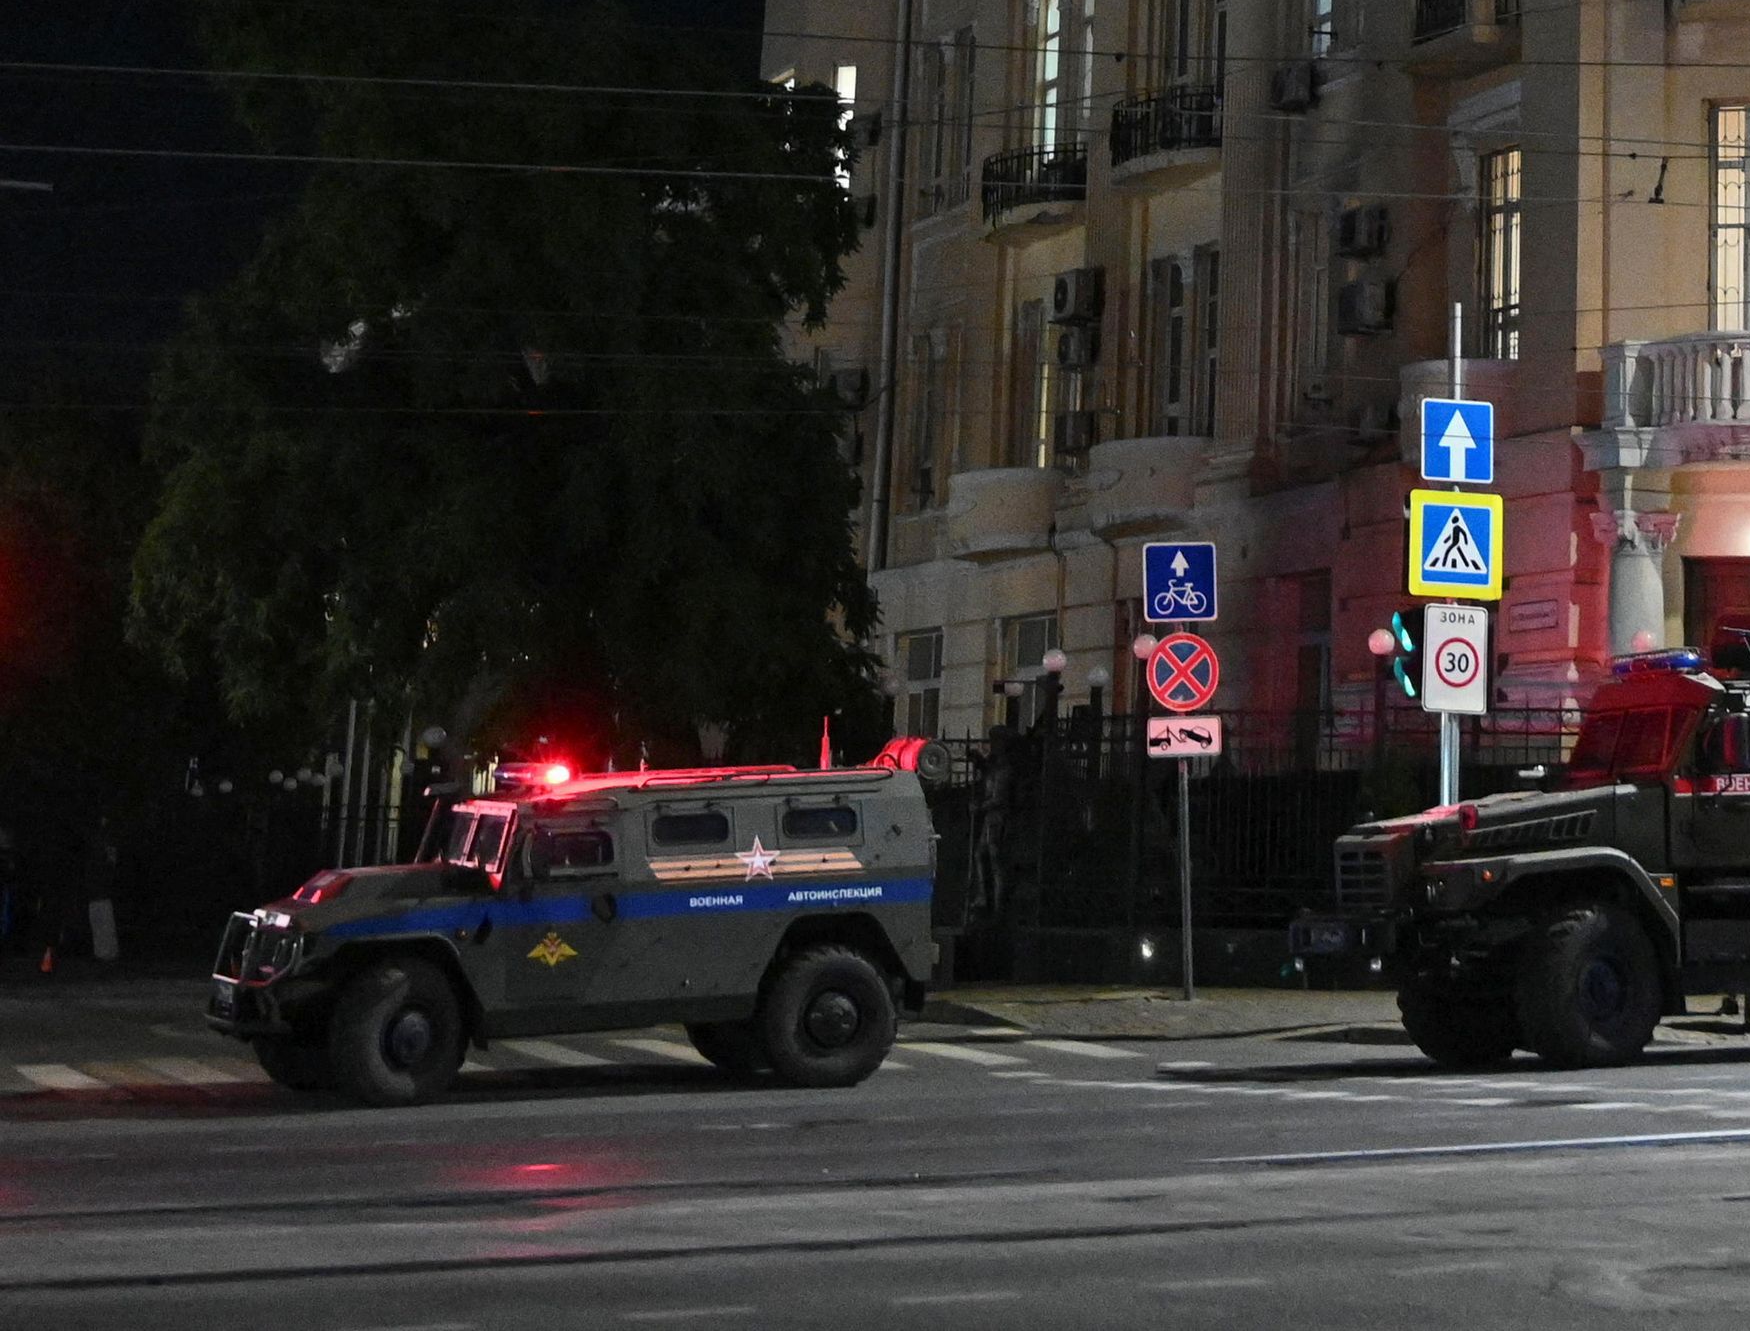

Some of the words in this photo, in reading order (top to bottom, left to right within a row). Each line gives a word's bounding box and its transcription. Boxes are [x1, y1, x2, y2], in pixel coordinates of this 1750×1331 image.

[1440, 612, 1475, 624] ЗОНА
[1444, 652, 1469, 673] 30
[689, 895, 743, 908] ВОЕННАЯ
[787, 886, 883, 902] АВТОИНСПЕКЦИЯ
